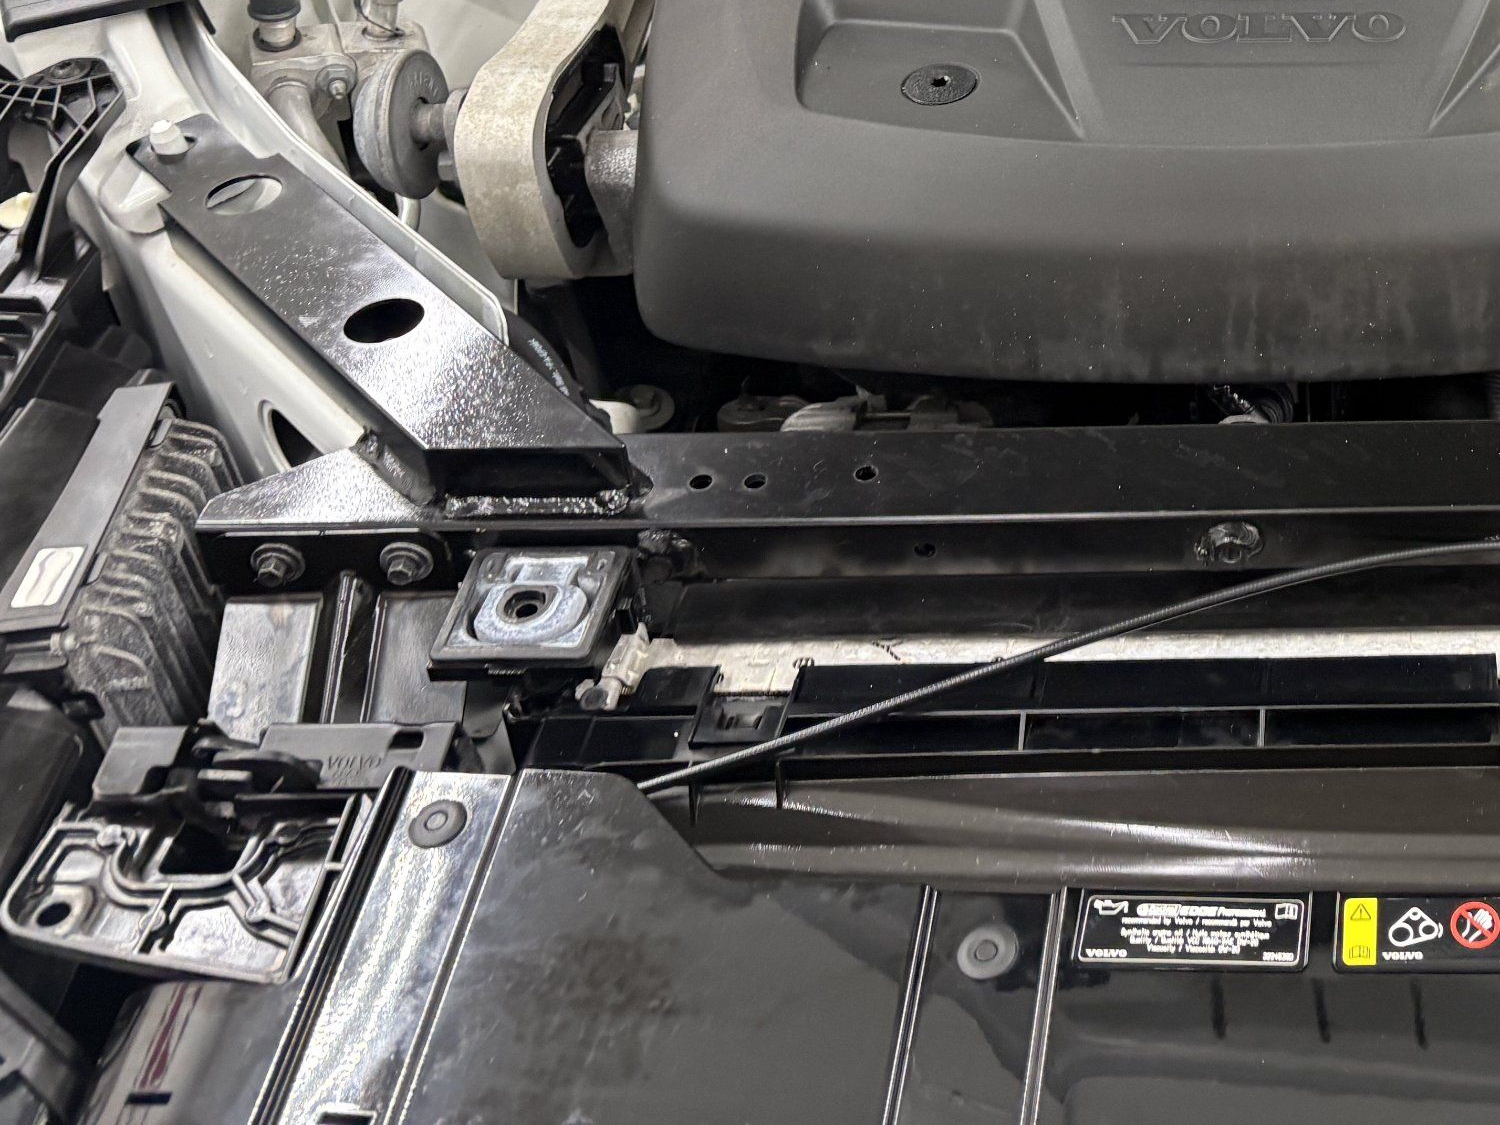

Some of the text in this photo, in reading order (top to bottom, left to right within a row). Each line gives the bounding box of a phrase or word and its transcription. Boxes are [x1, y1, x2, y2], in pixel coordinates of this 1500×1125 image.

[1112, 12, 1407, 44] VOLVO
[1085, 949, 1127, 958] VOLVO
[1381, 951, 1424, 961] VOLVO
